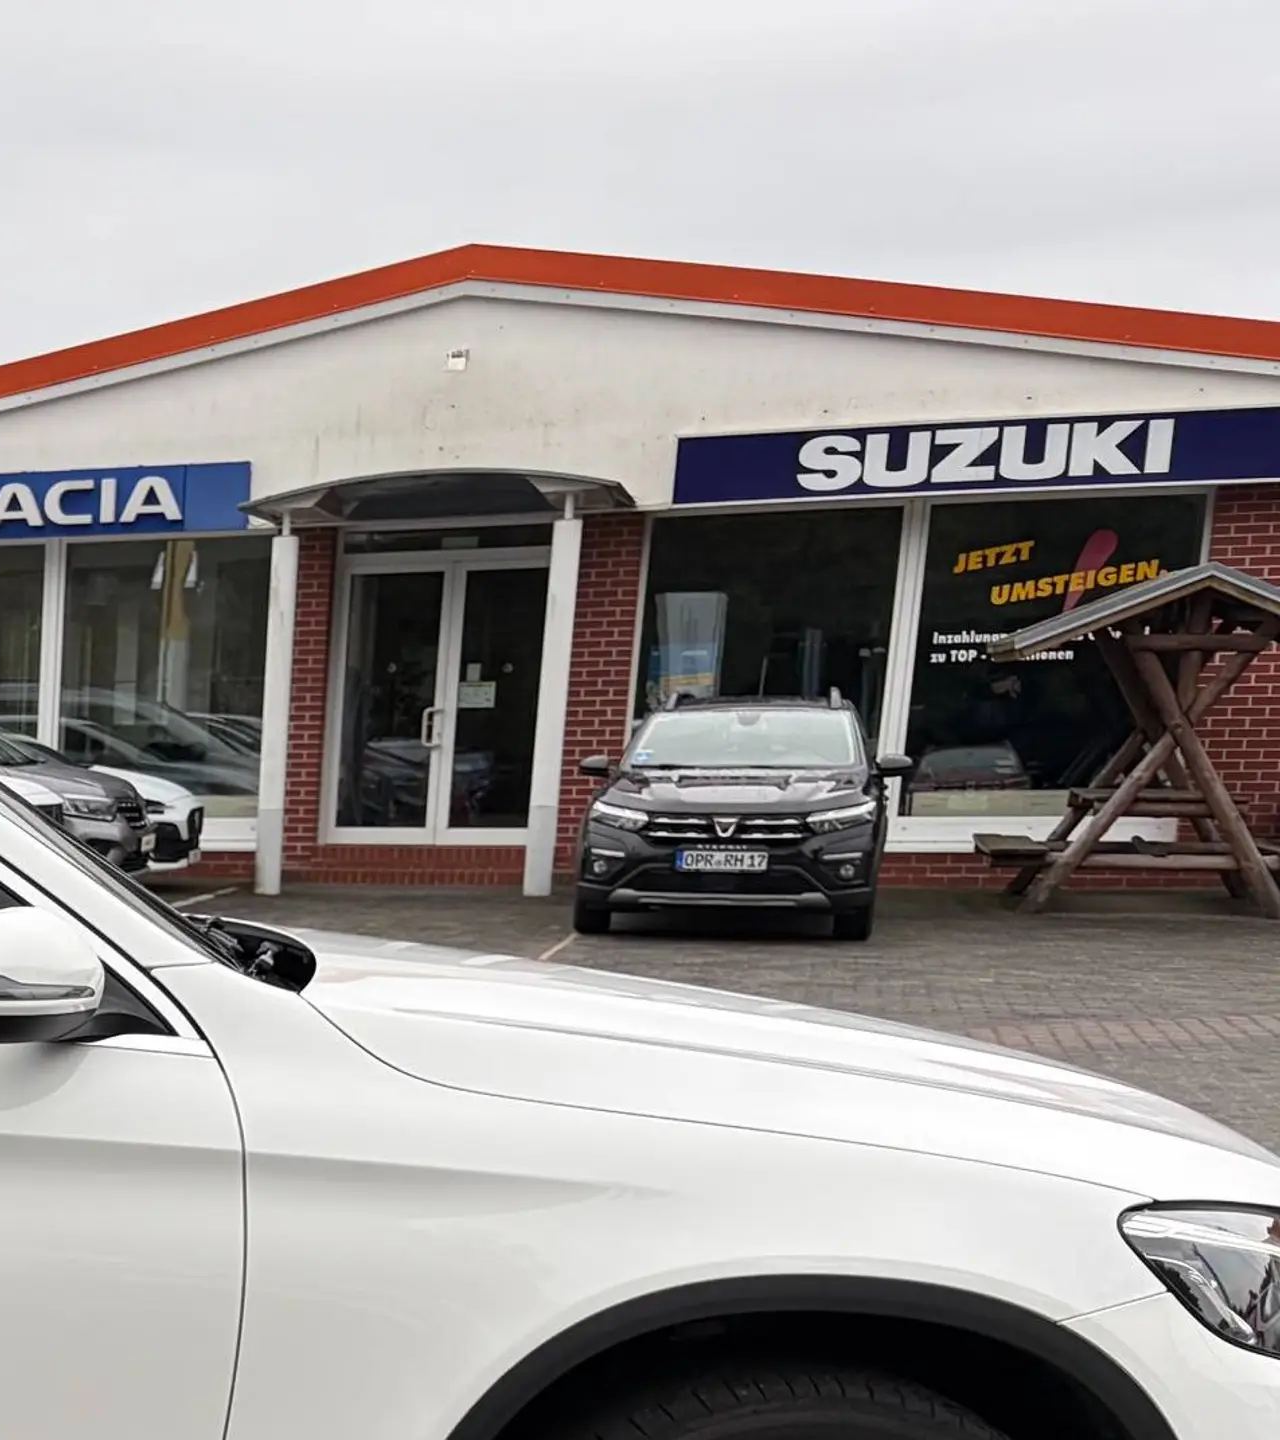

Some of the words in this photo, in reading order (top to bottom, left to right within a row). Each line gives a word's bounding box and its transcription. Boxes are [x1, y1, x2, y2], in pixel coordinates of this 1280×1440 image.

[796, 418, 1175, 492] SUZUKI
[953, 540, 1035, 574] JETZT
[929, 652, 947, 663] zu
[949, 649, 978, 662] TOP
